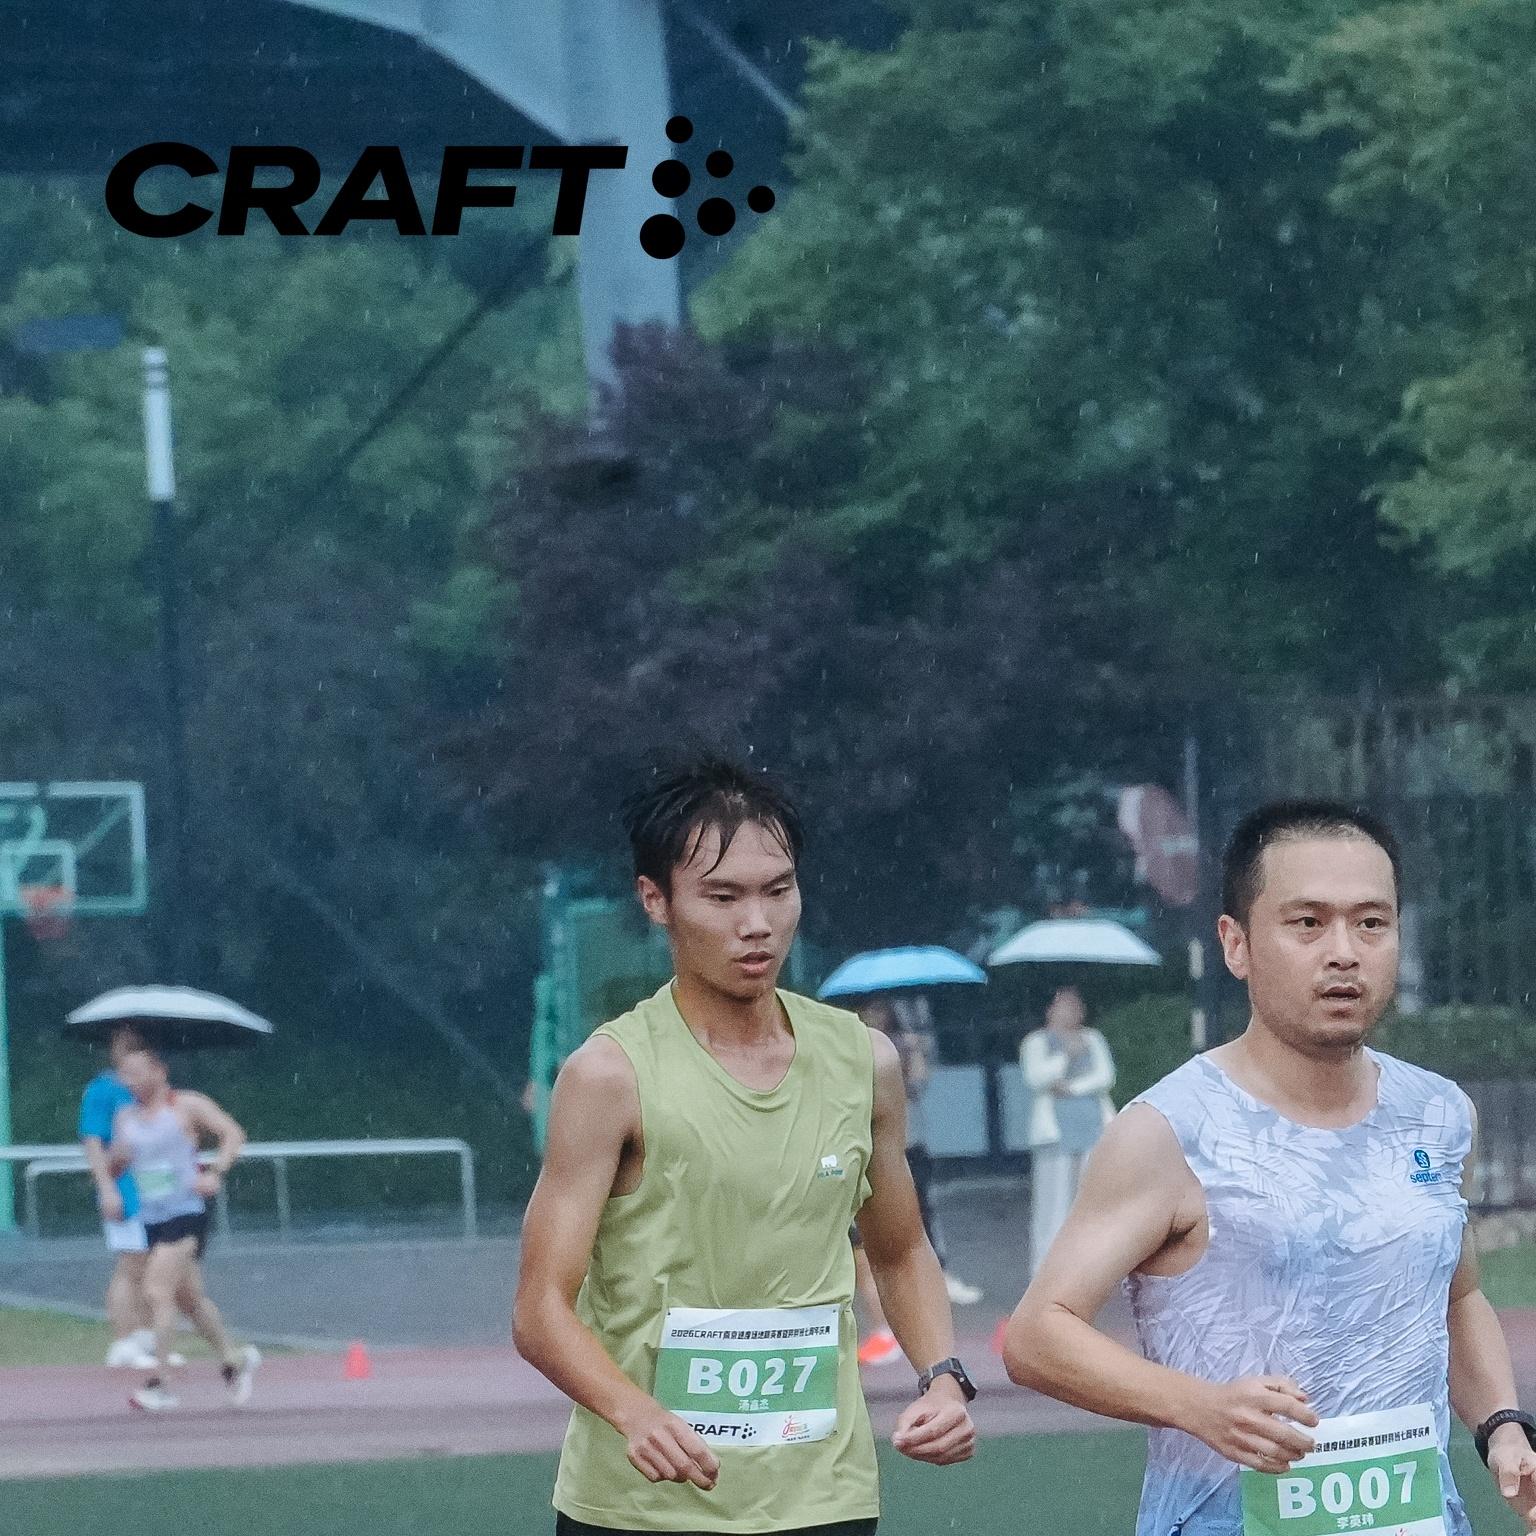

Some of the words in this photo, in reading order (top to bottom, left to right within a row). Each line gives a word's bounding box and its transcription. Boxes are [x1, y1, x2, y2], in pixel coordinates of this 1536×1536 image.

[687, 1356, 817, 1396] B027
[688, 1423, 741, 1436] RAFT
[1277, 1461, 1417, 1519] B007
